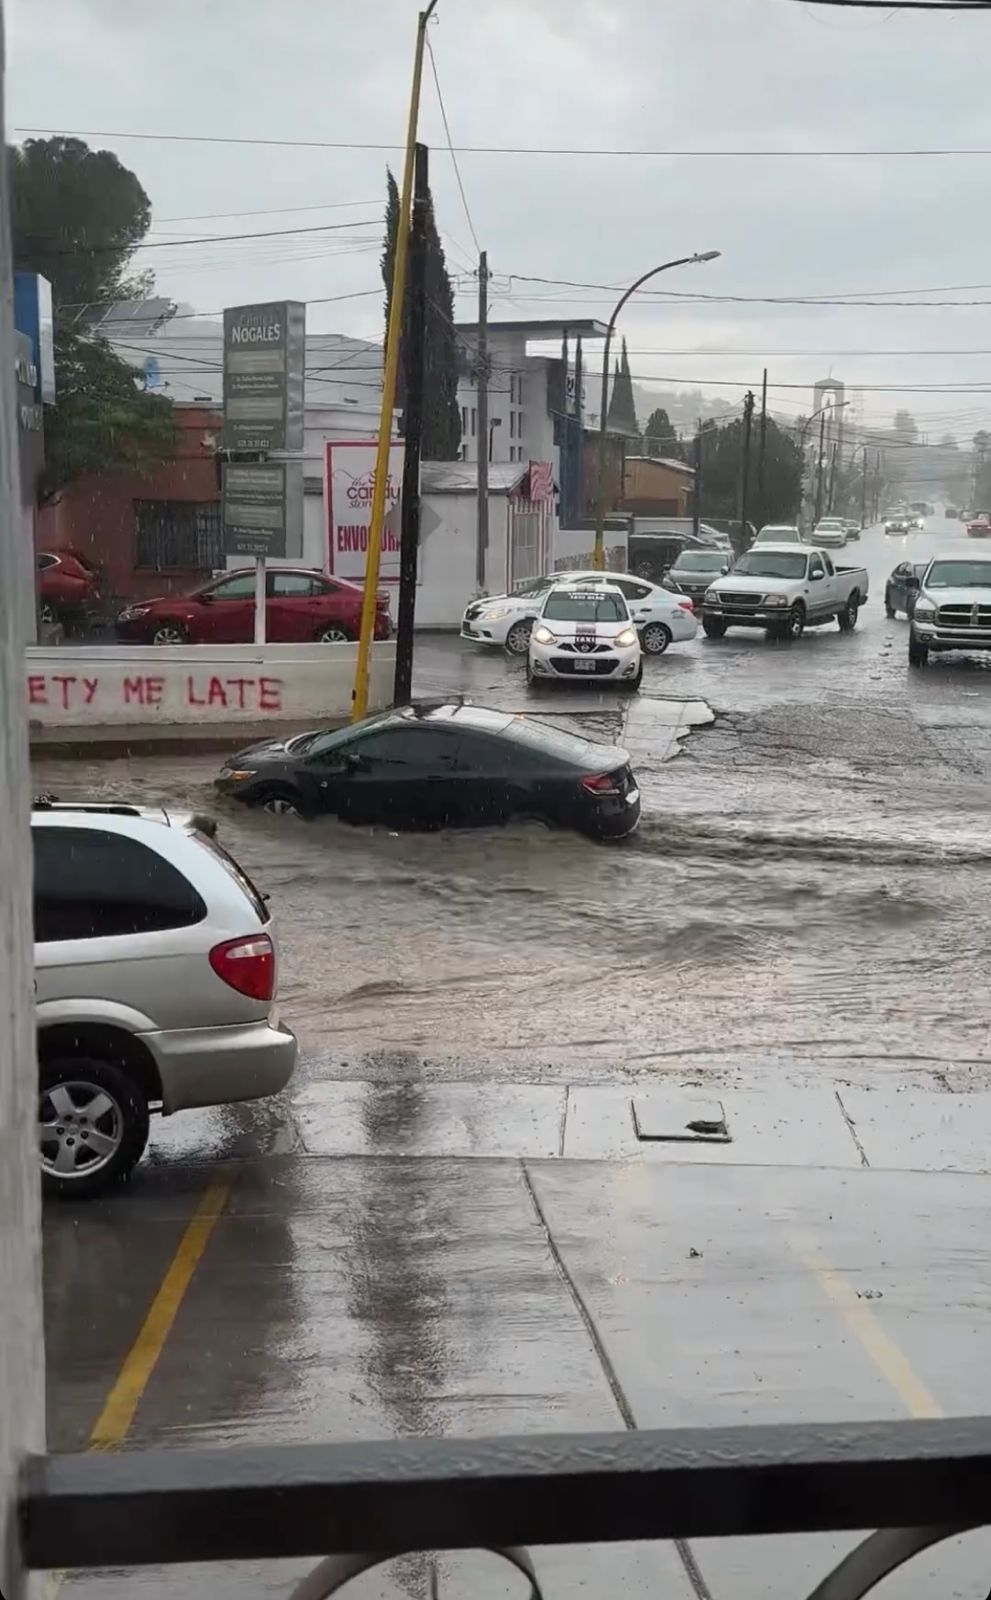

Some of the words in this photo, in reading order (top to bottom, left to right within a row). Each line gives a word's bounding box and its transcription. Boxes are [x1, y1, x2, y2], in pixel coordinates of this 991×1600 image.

[231, 323, 281, 344] NOGALES
[123, 676, 165, 705] ME
[187, 675, 283, 712] LATE
